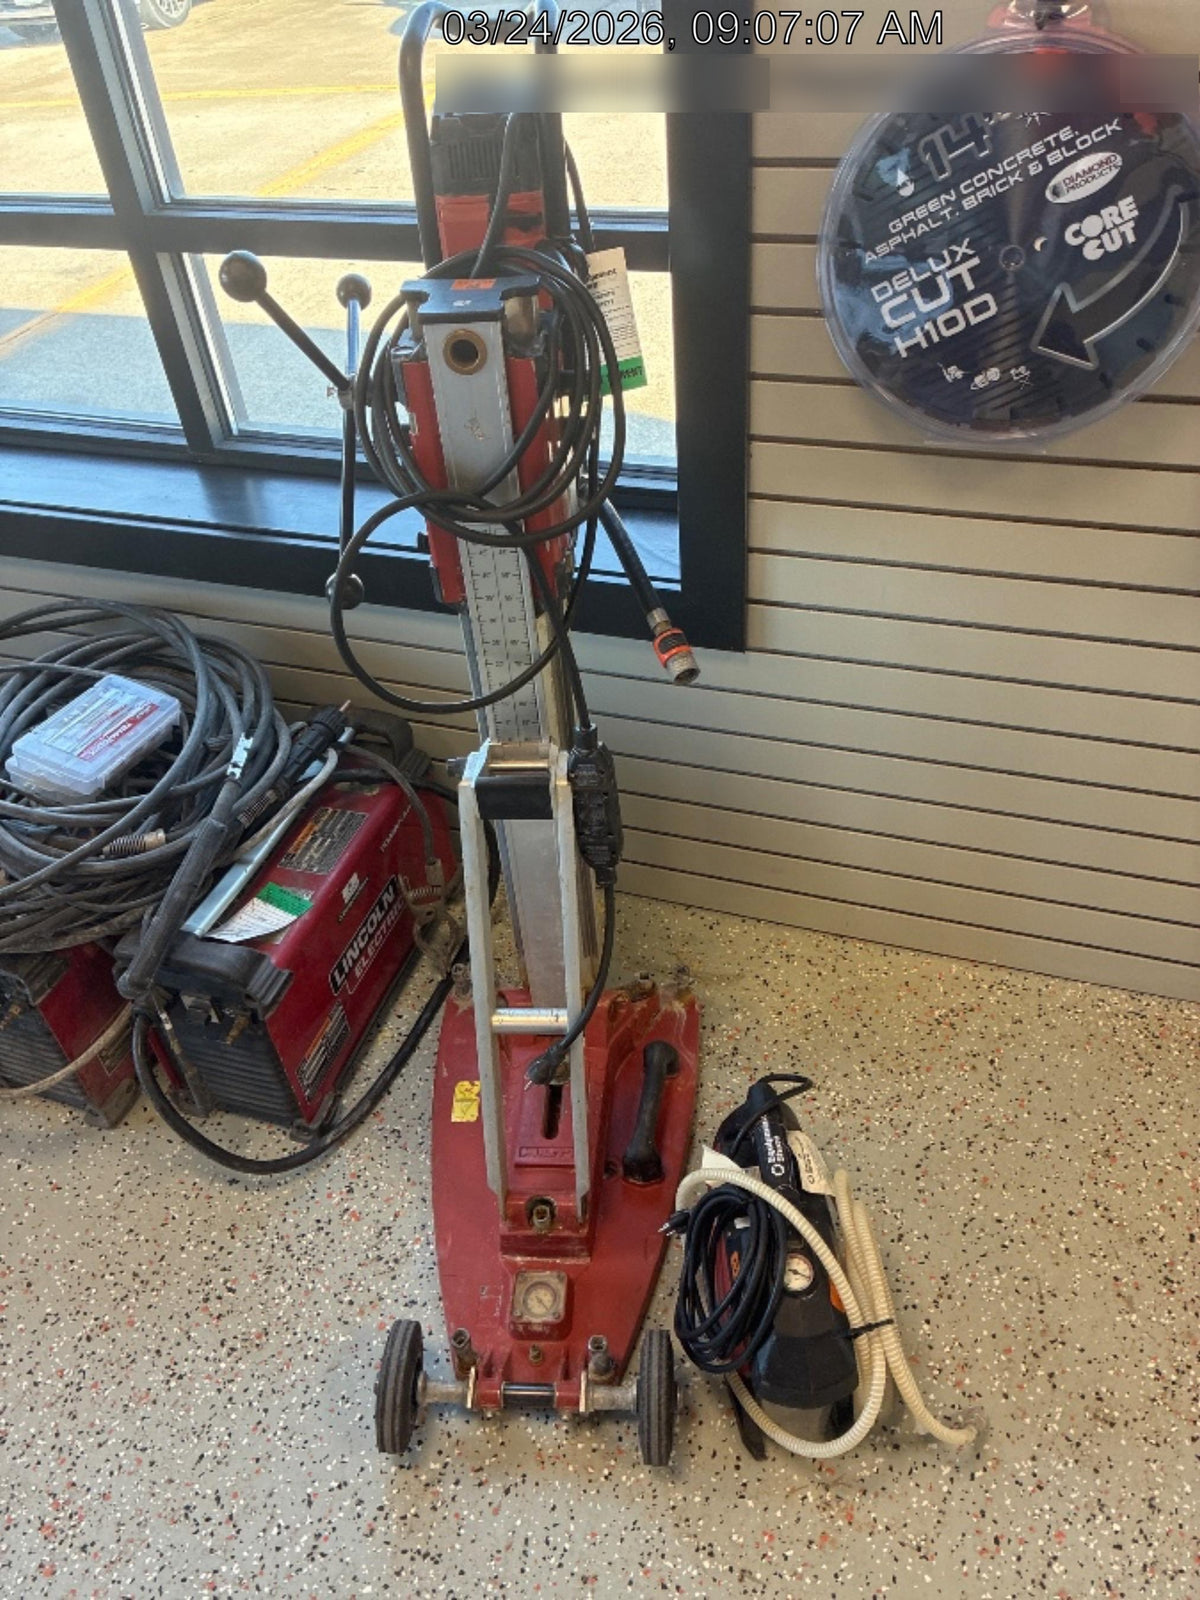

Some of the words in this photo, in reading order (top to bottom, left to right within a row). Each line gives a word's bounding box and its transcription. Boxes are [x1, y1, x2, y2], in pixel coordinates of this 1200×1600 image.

[961, 169, 1024, 211] BRICK
[1046, 118, 1123, 167] BLOCK
[1062, 153, 1118, 187] DIAMOND
[888, 189, 956, 234] GREEN
[1064, 195, 1139, 247] CORE
[1082, 220, 1137, 261] CUT
[871, 238, 977, 303] DELUX
[881, 255, 981, 329] CUT
[894, 292, 999, 358] H10D
[333, 884, 395, 986] LINCOLN
